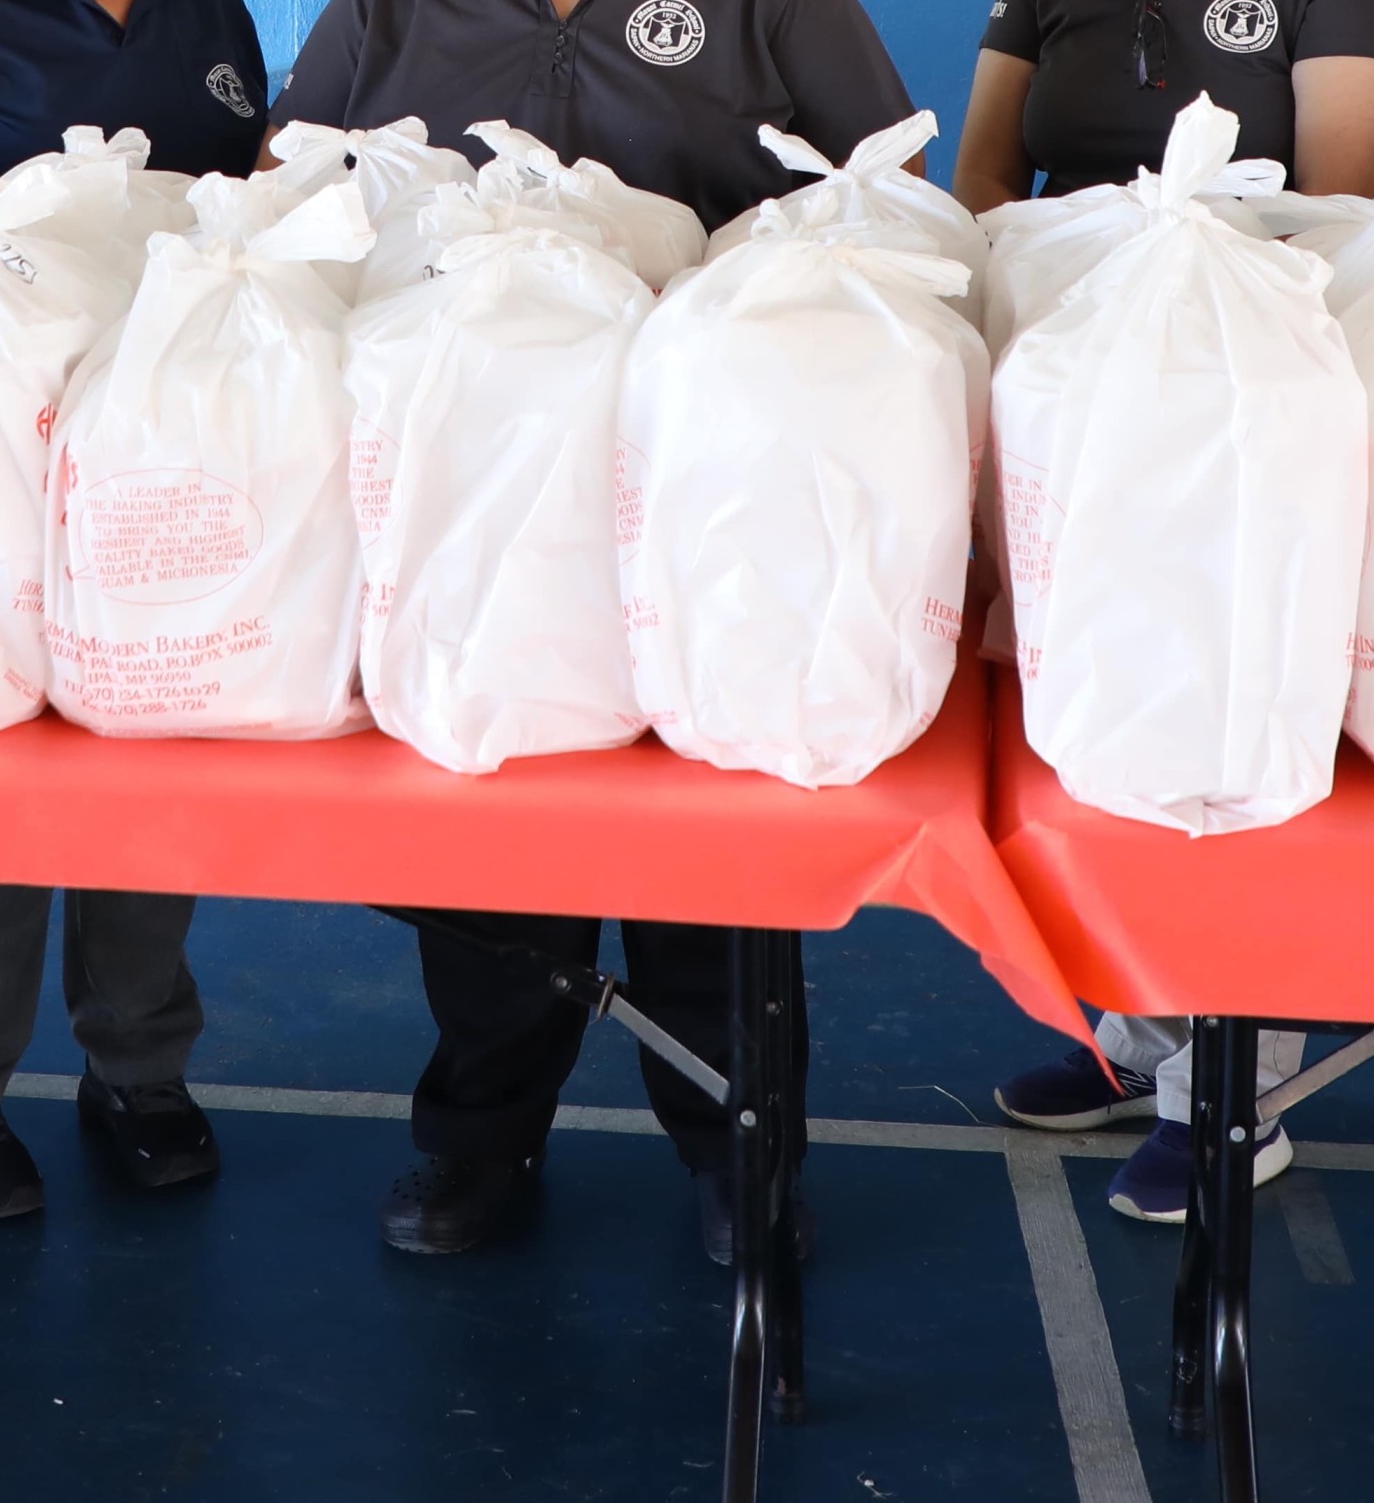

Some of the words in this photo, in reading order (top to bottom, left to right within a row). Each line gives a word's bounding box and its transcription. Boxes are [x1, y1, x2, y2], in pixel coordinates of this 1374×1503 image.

[129, 486, 180, 498] LEADER
[188, 482, 201, 493] IN
[113, 500, 162, 511] BAKING
[92, 511, 178, 524] ESTABLISHED
[186, 509, 199, 519] IN
[118, 524, 159, 536] BRING
[167, 522, 194, 534] YOU
[202, 521, 227, 531] THE
[155, 537, 181, 546] AND
[150, 544, 194, 557] BAKED
[162, 557, 174, 568] IN
[183, 553, 209, 565] THE
[141, 574, 149, 584] &
[157, 563, 238, 581] MICRONESIA
[232, 615, 271, 636] INC.
[202, 681, 221, 696] 29
